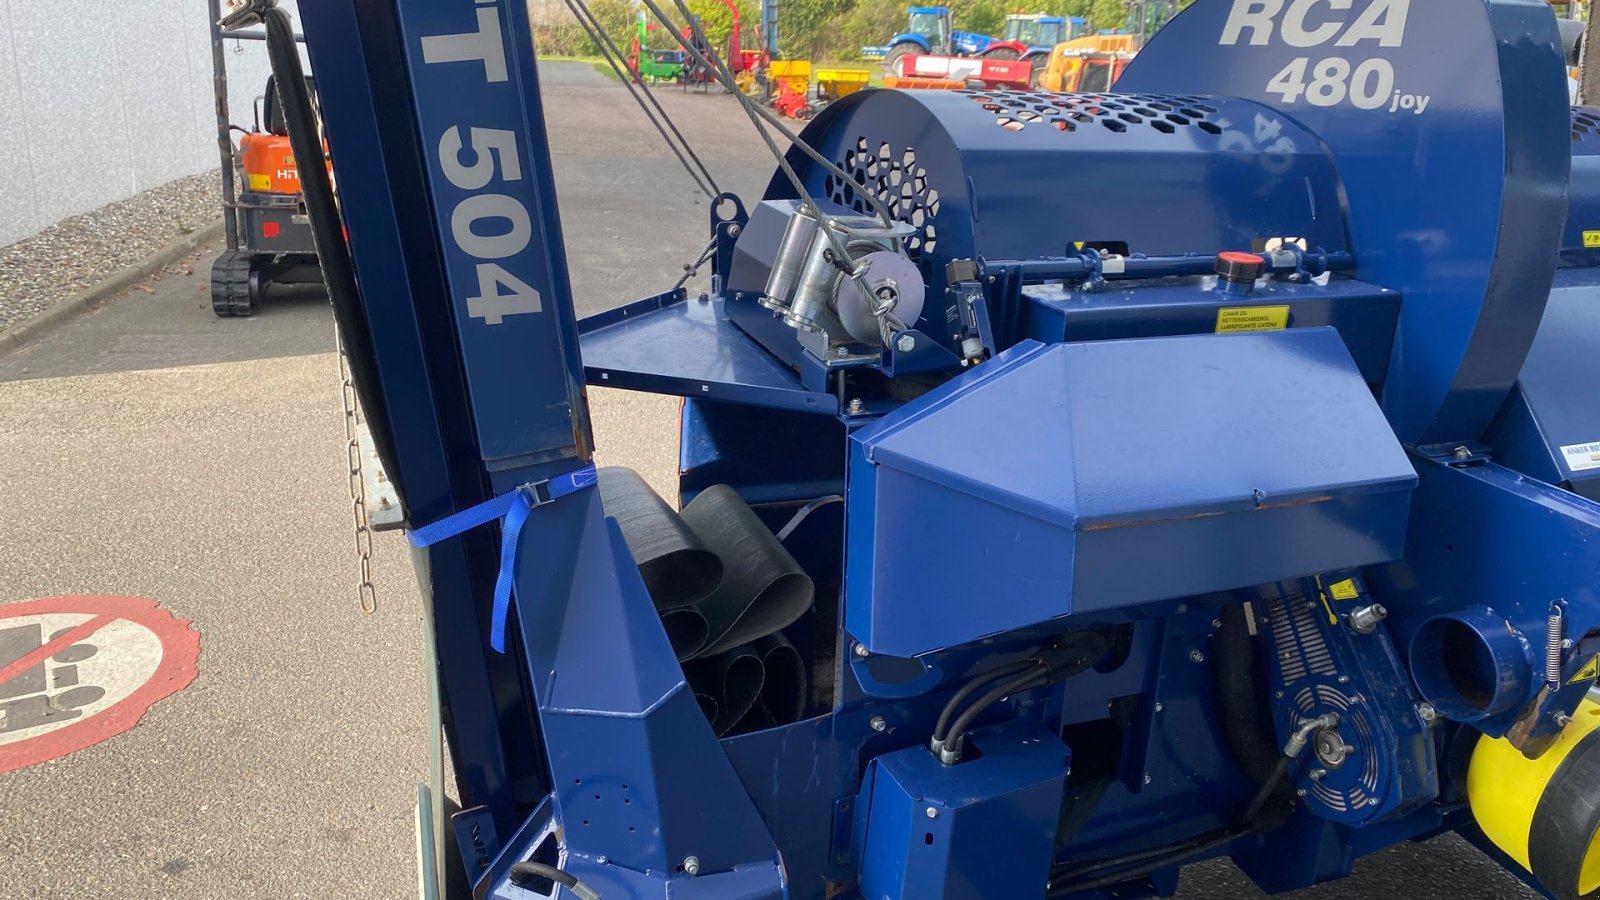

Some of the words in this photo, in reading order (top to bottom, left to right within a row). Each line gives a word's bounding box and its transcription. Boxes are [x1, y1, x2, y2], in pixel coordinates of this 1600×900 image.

[421, 0, 509, 82] T
[1218, 0, 1410, 47] RCA
[1265, 57, 1394, 109] 480
[1389, 90, 1430, 114] joy
[439, 125, 543, 325] 504
